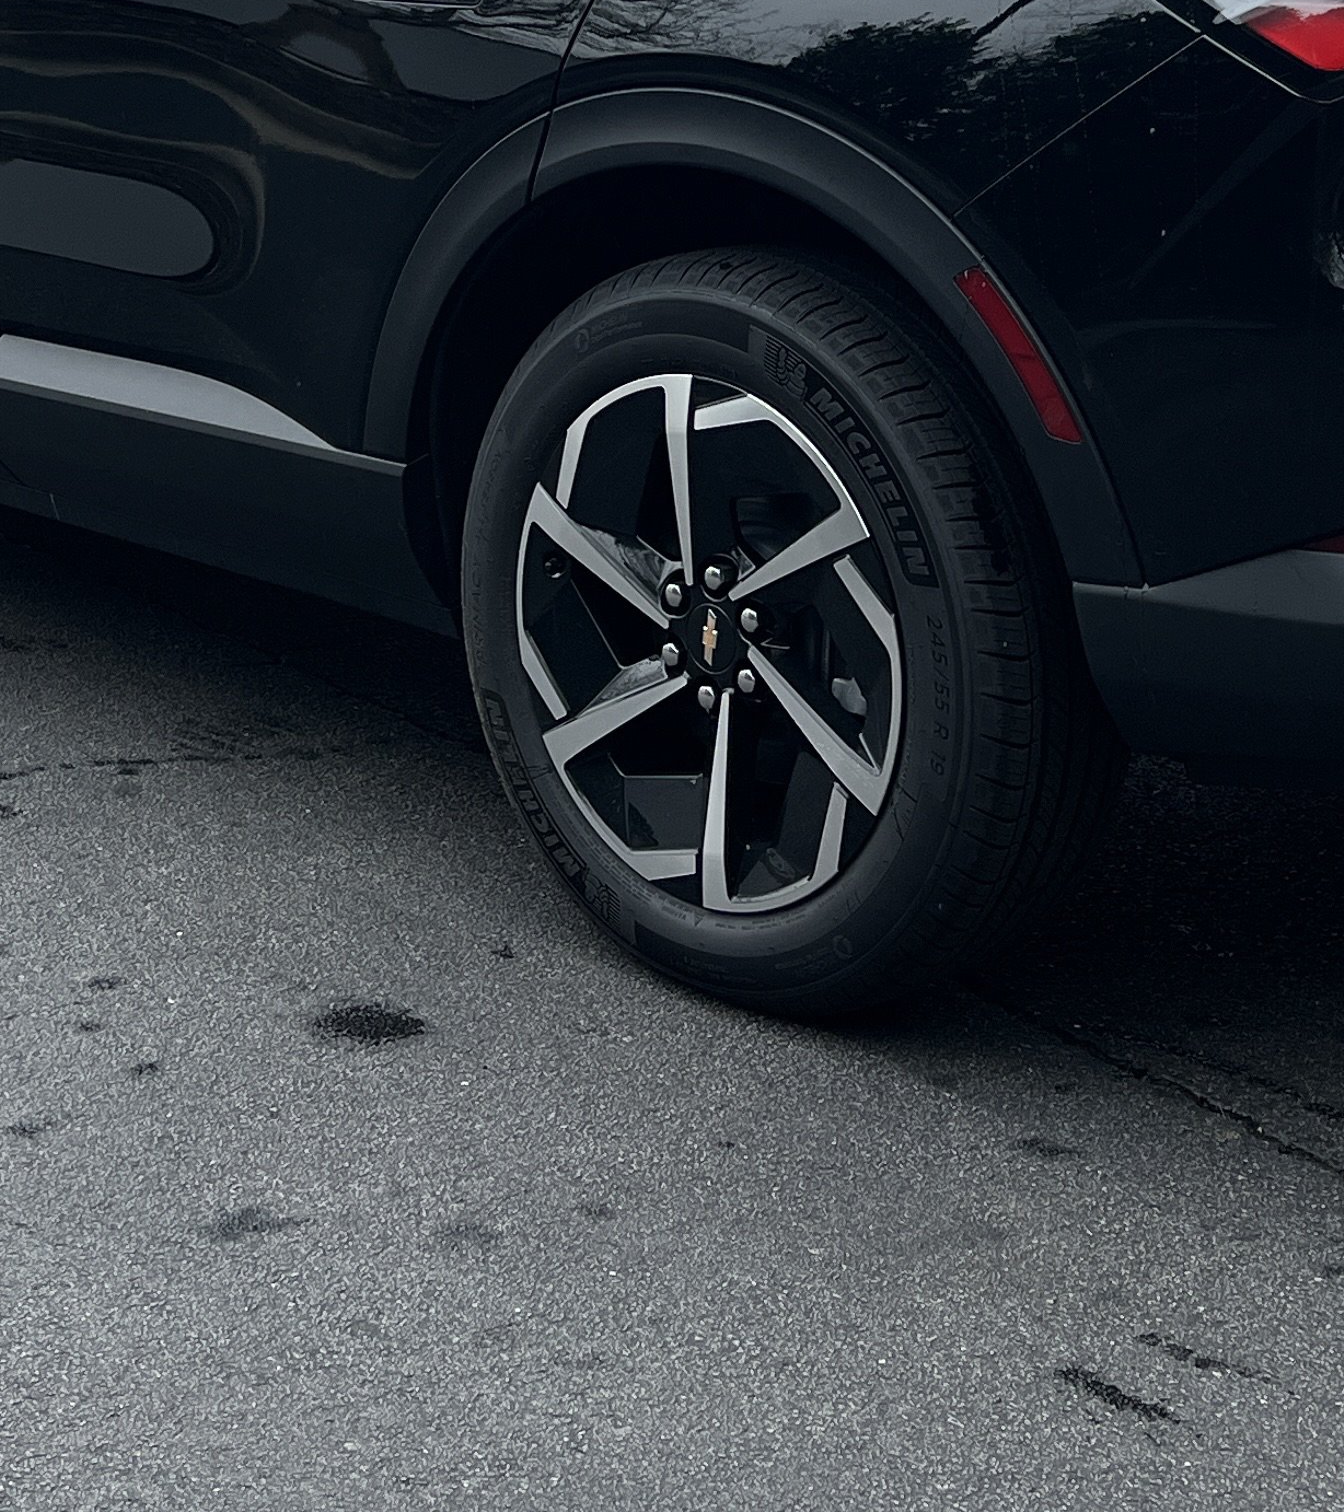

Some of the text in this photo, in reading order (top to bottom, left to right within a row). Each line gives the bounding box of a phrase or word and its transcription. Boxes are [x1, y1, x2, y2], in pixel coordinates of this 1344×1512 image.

[810, 386, 930, 577] MICHELIN
[926, 614, 951, 777] 245/55 R 19
[485, 697, 581, 878] MICHELIN
